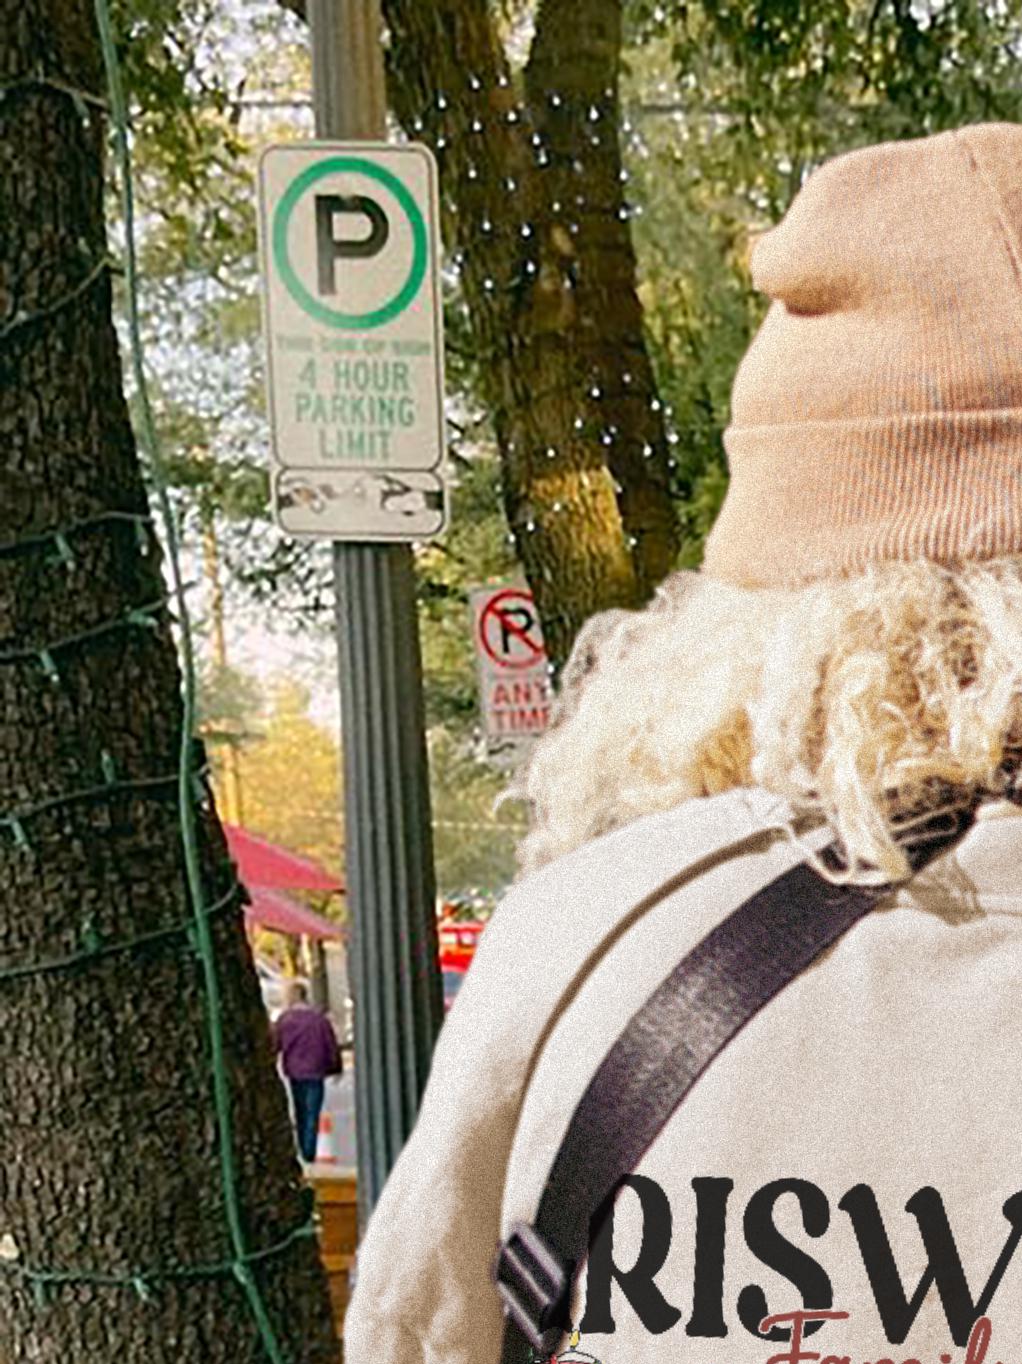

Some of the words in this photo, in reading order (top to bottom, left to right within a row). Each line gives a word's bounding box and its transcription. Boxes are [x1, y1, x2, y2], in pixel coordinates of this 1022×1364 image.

[313, 193, 390, 296] P
[298, 357, 318, 390] 4
[333, 359, 410, 392] HOUR
[295, 392, 416, 428] PARKING
[318, 428, 394, 460] LIMIT
